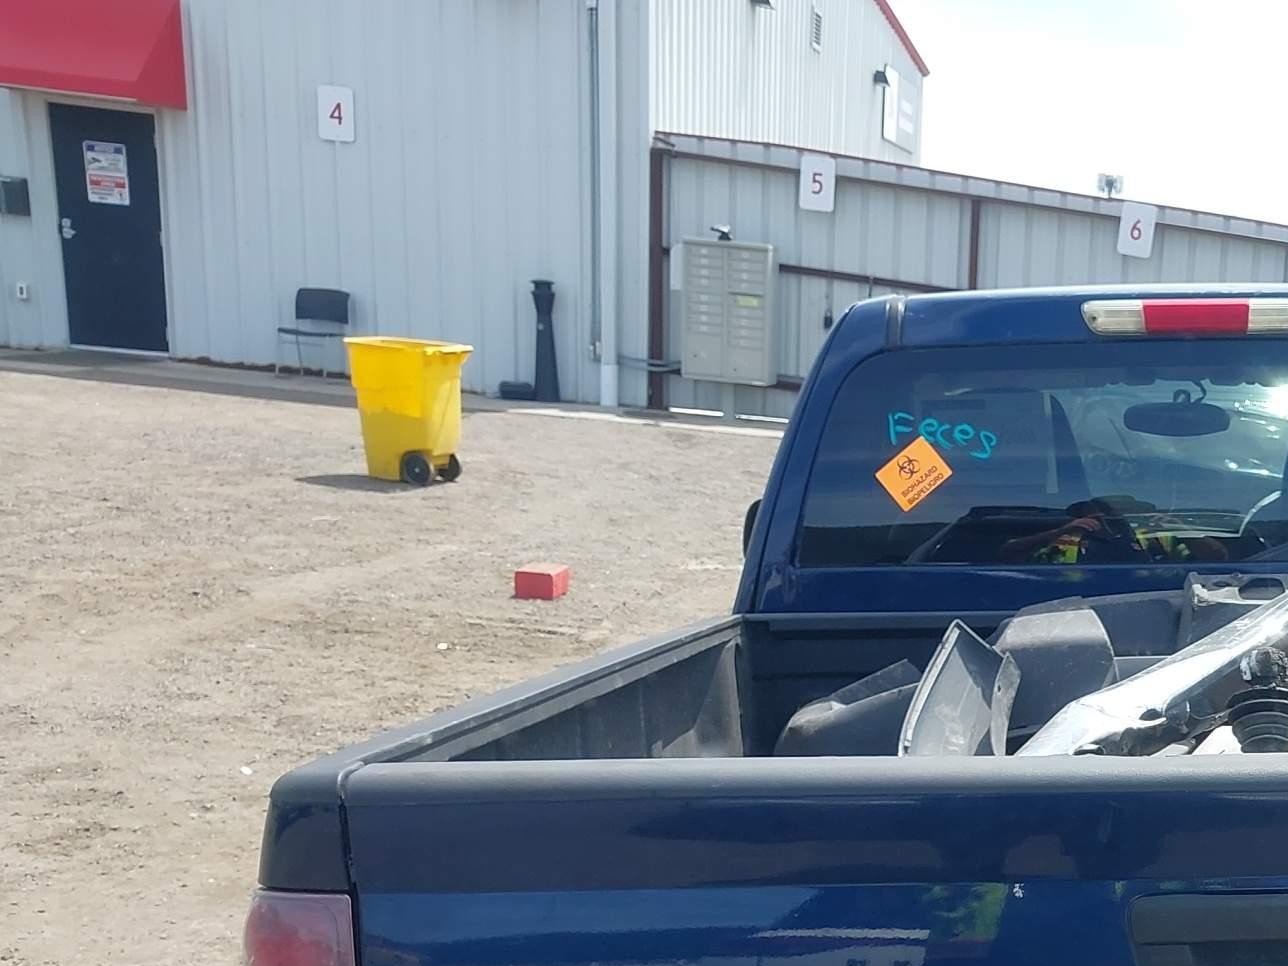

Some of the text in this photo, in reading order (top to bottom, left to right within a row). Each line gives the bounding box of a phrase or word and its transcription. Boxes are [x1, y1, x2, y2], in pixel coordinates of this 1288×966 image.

[329, 102, 343, 126] 4
[811, 172, 823, 195] 5
[1130, 219, 1142, 241] 6
[900, 465, 938, 498] BIOHAZARD
[907, 473, 945, 505] BIOPELIGRO
